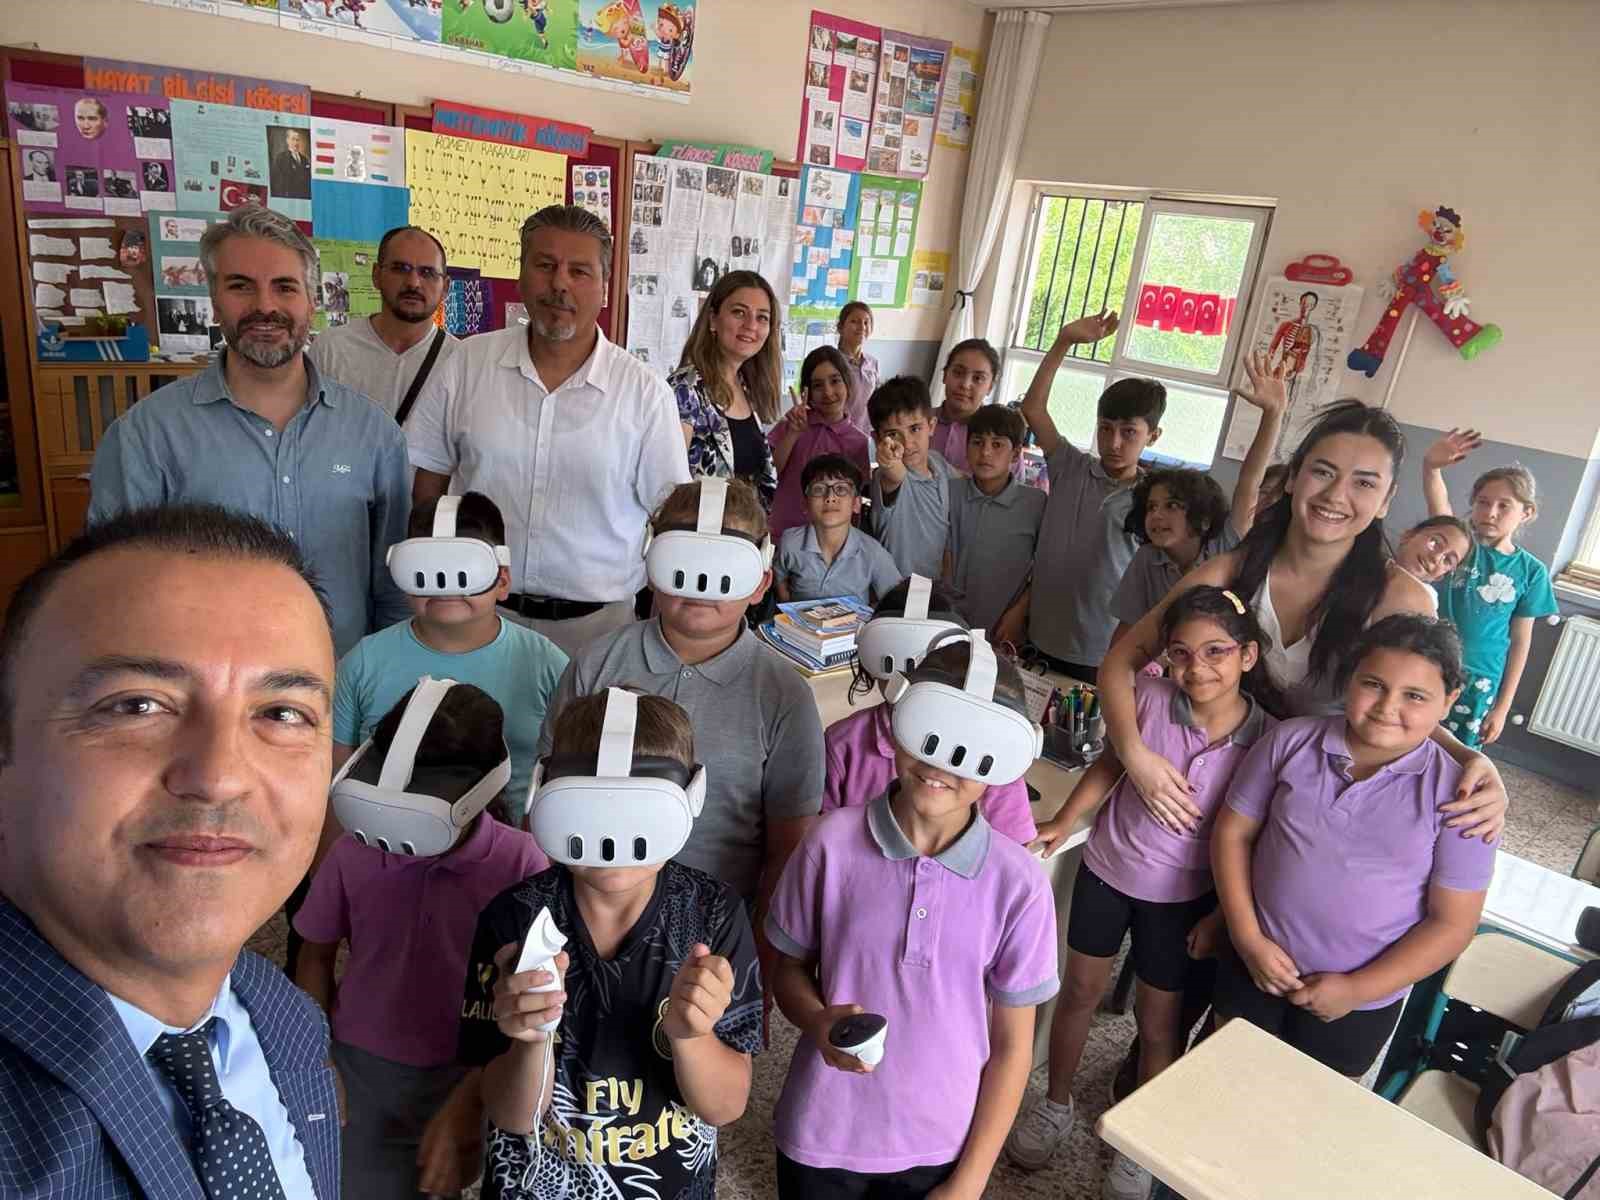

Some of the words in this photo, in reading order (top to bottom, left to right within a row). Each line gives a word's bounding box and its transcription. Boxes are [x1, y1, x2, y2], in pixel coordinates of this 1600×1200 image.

[84, 64, 153, 94] HAYAT
[585, 1076, 644, 1116] Fly
[543, 1106, 697, 1167] mirate
